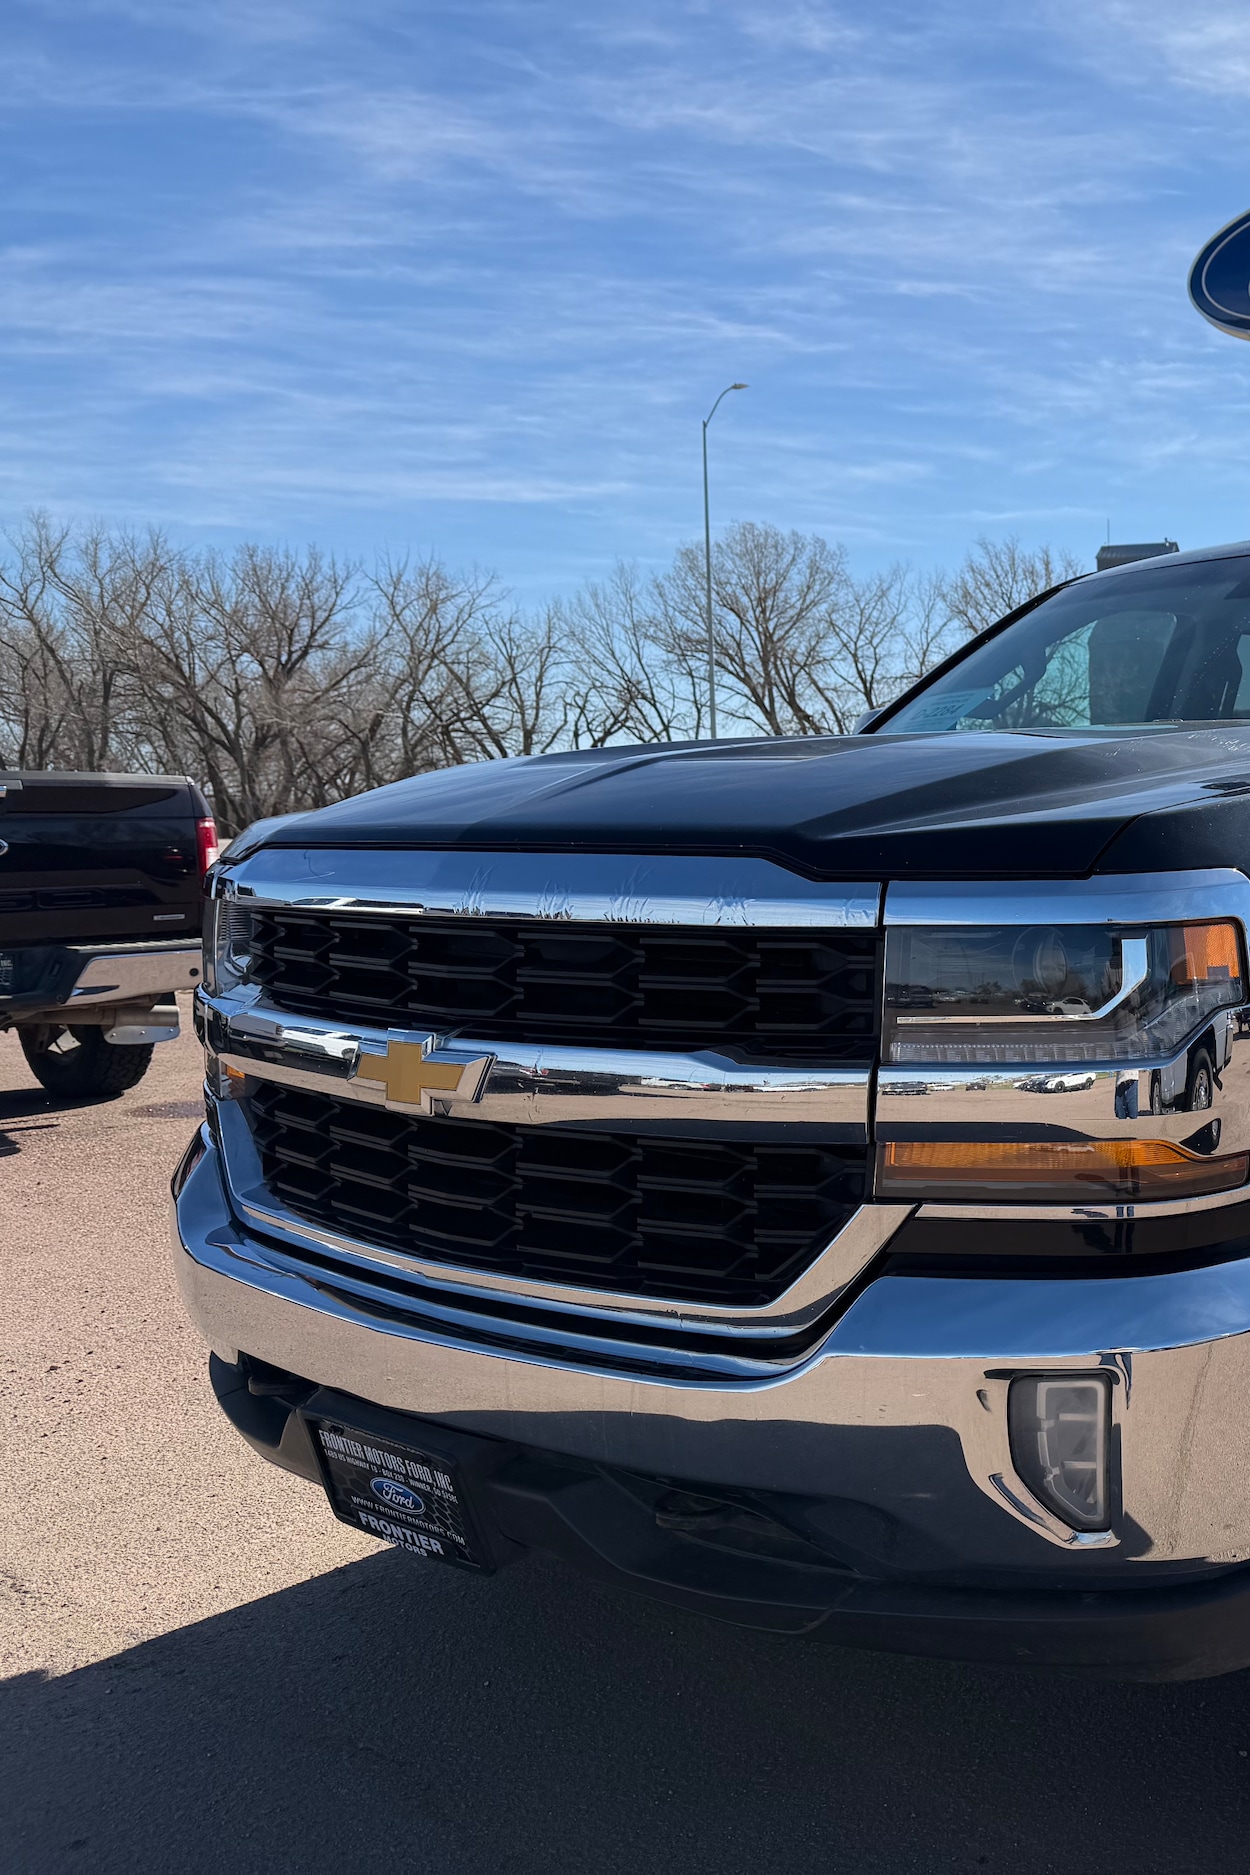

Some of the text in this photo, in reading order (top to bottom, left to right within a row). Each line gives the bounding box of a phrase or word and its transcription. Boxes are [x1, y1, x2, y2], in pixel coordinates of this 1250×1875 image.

[318, 1429, 365, 1458] FRONTIER
[364, 1445, 407, 1474] MOTORS
[433, 1470, 454, 1493] INC
[345, 1455, 370, 1471] HIGHWAY
[382, 1482, 416, 1510] Ford
[358, 1510, 445, 1556] FRONTIER
[382, 1533, 428, 1557] MOTORS
